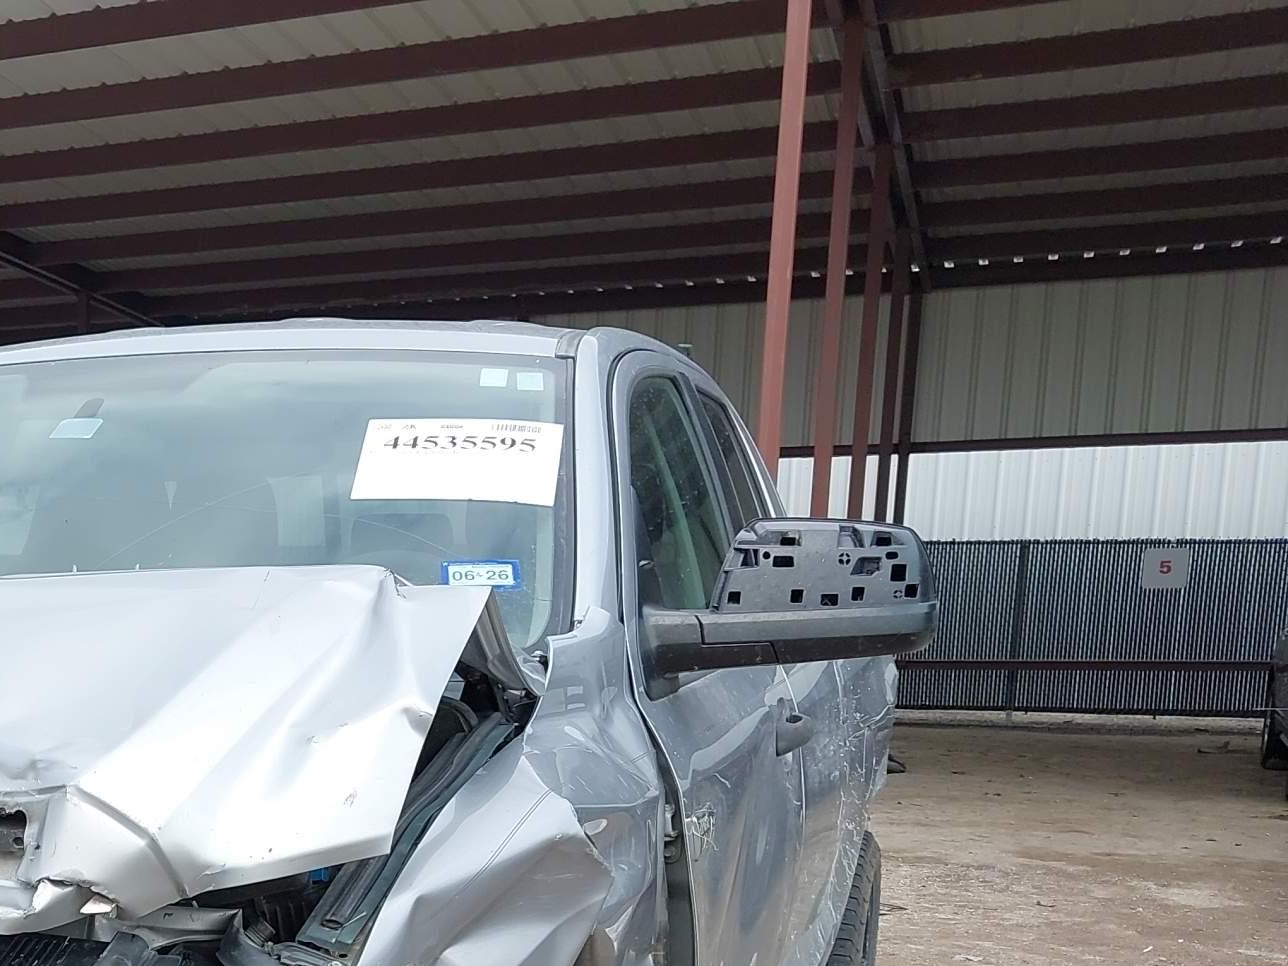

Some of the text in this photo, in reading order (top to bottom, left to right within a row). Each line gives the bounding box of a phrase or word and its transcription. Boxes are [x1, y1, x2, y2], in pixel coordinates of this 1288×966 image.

[383, 435, 537, 452] 44535595
[1159, 560, 1172, 574] 5
[452, 570, 509, 581] 06 26
